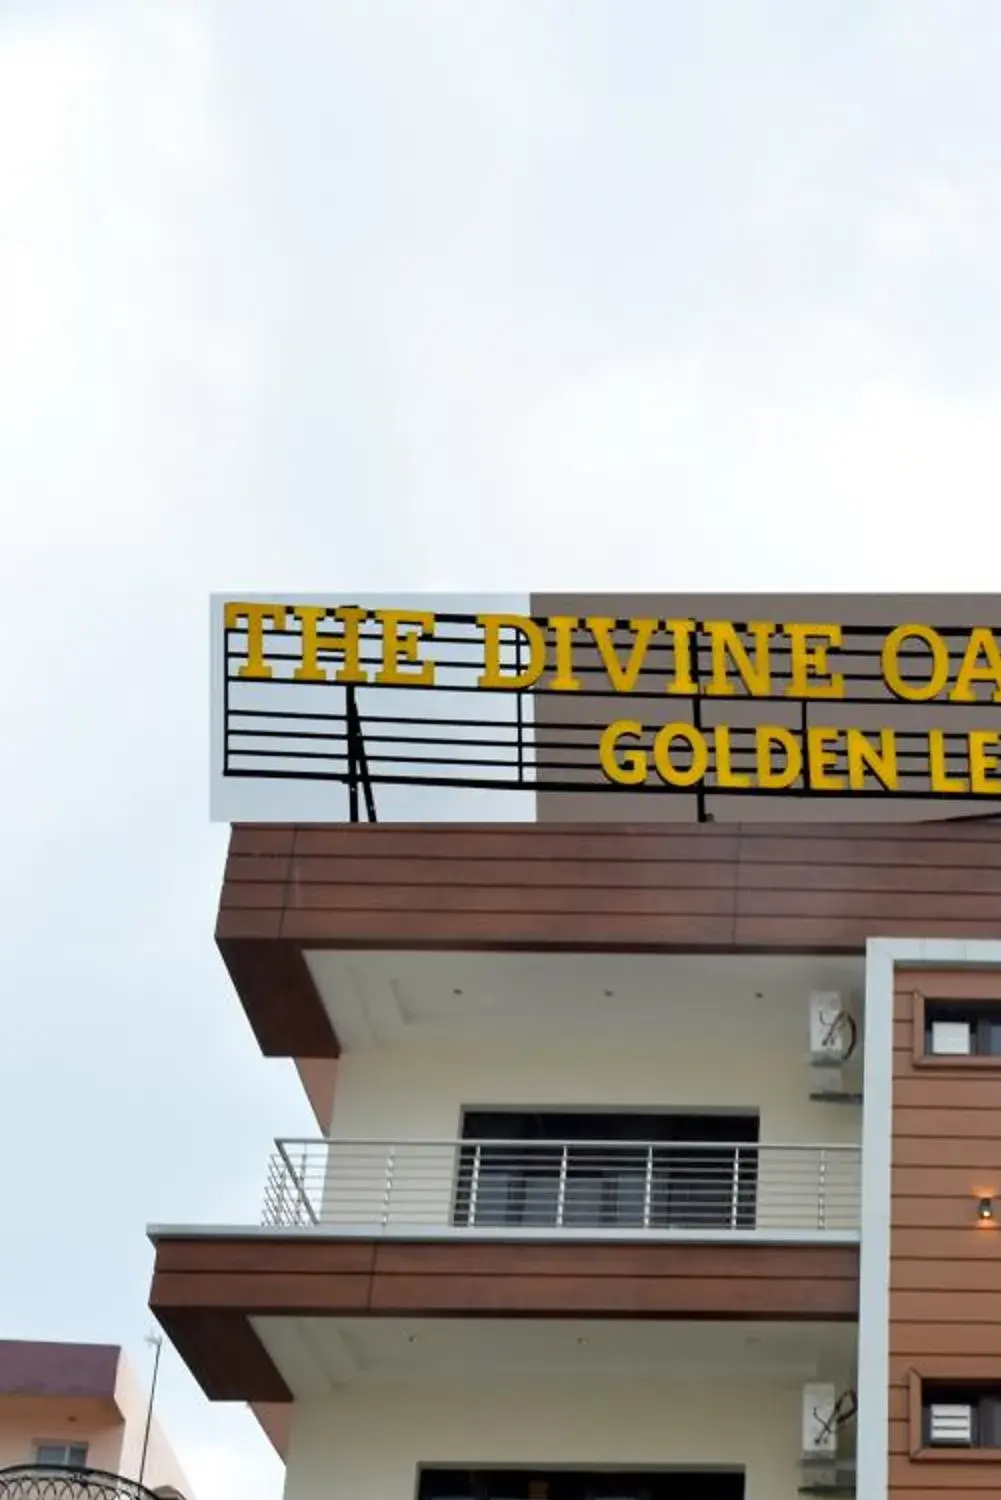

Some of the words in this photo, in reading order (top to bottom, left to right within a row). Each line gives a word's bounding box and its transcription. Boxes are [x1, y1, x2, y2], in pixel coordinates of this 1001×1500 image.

[224, 602, 435, 684] THE
[477, 614, 843, 699] DIVINE
[599, 719, 898, 791] GOLDEN
